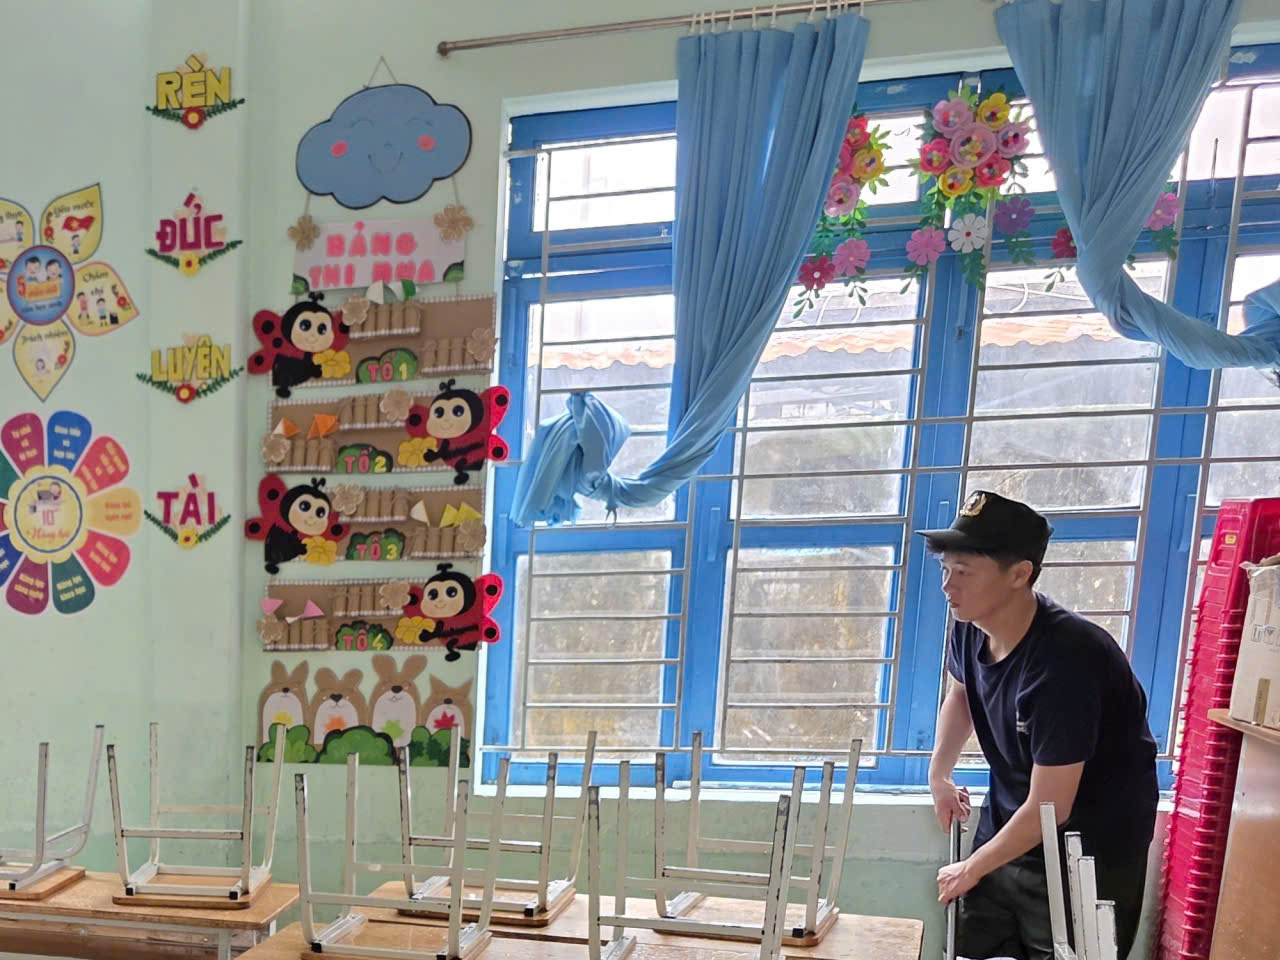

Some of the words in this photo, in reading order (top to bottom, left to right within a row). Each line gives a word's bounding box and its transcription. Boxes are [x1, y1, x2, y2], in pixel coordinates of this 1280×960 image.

[156, 54, 232, 111] RÈN
[155, 192, 226, 254] ĐỨC
[399, 362, 408, 381] 1
[374, 455, 387, 473] 2
[156, 472, 216, 527] TÀI
[386, 543, 398, 560] 3
[372, 633, 383, 650] 4
